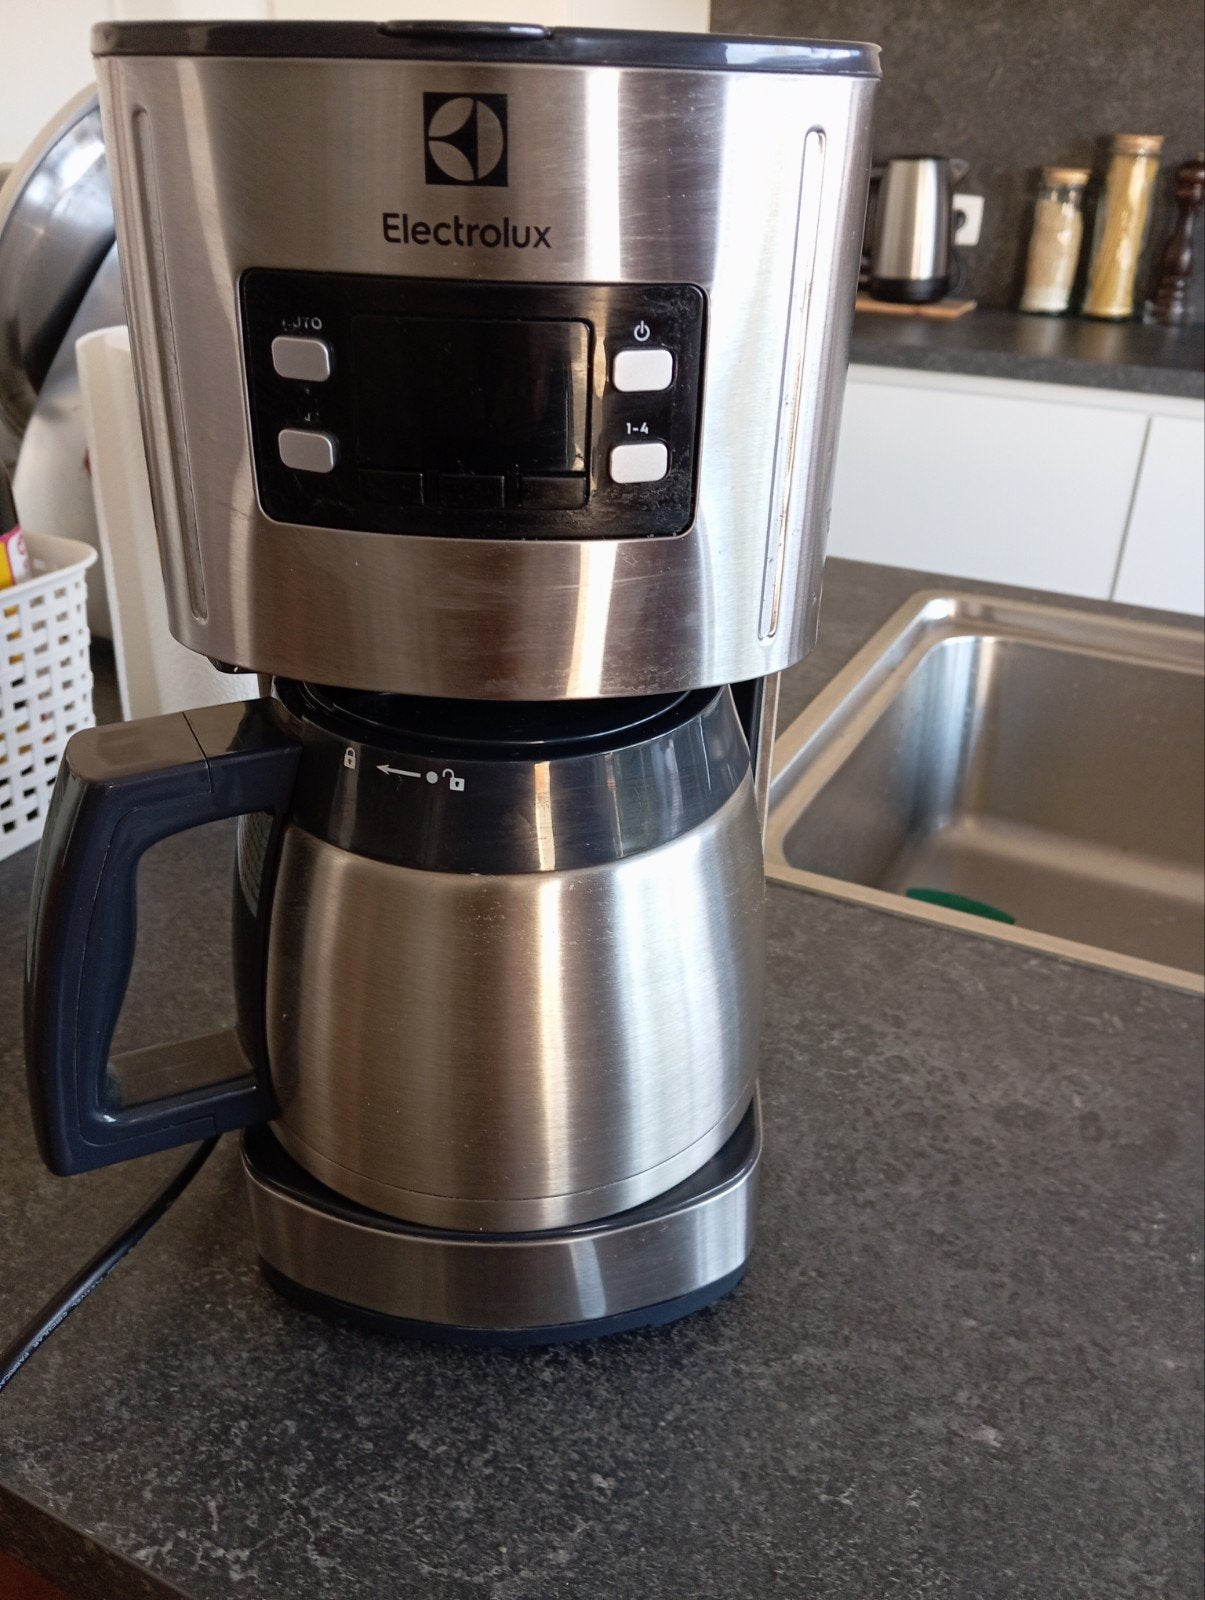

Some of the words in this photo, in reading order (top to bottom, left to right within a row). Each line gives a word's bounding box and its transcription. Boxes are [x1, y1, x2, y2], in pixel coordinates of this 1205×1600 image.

[382, 212, 552, 248] Electrolux
[626, 421, 650, 436] 1-4
[0, 1351, 30, 1389] FABRICA
